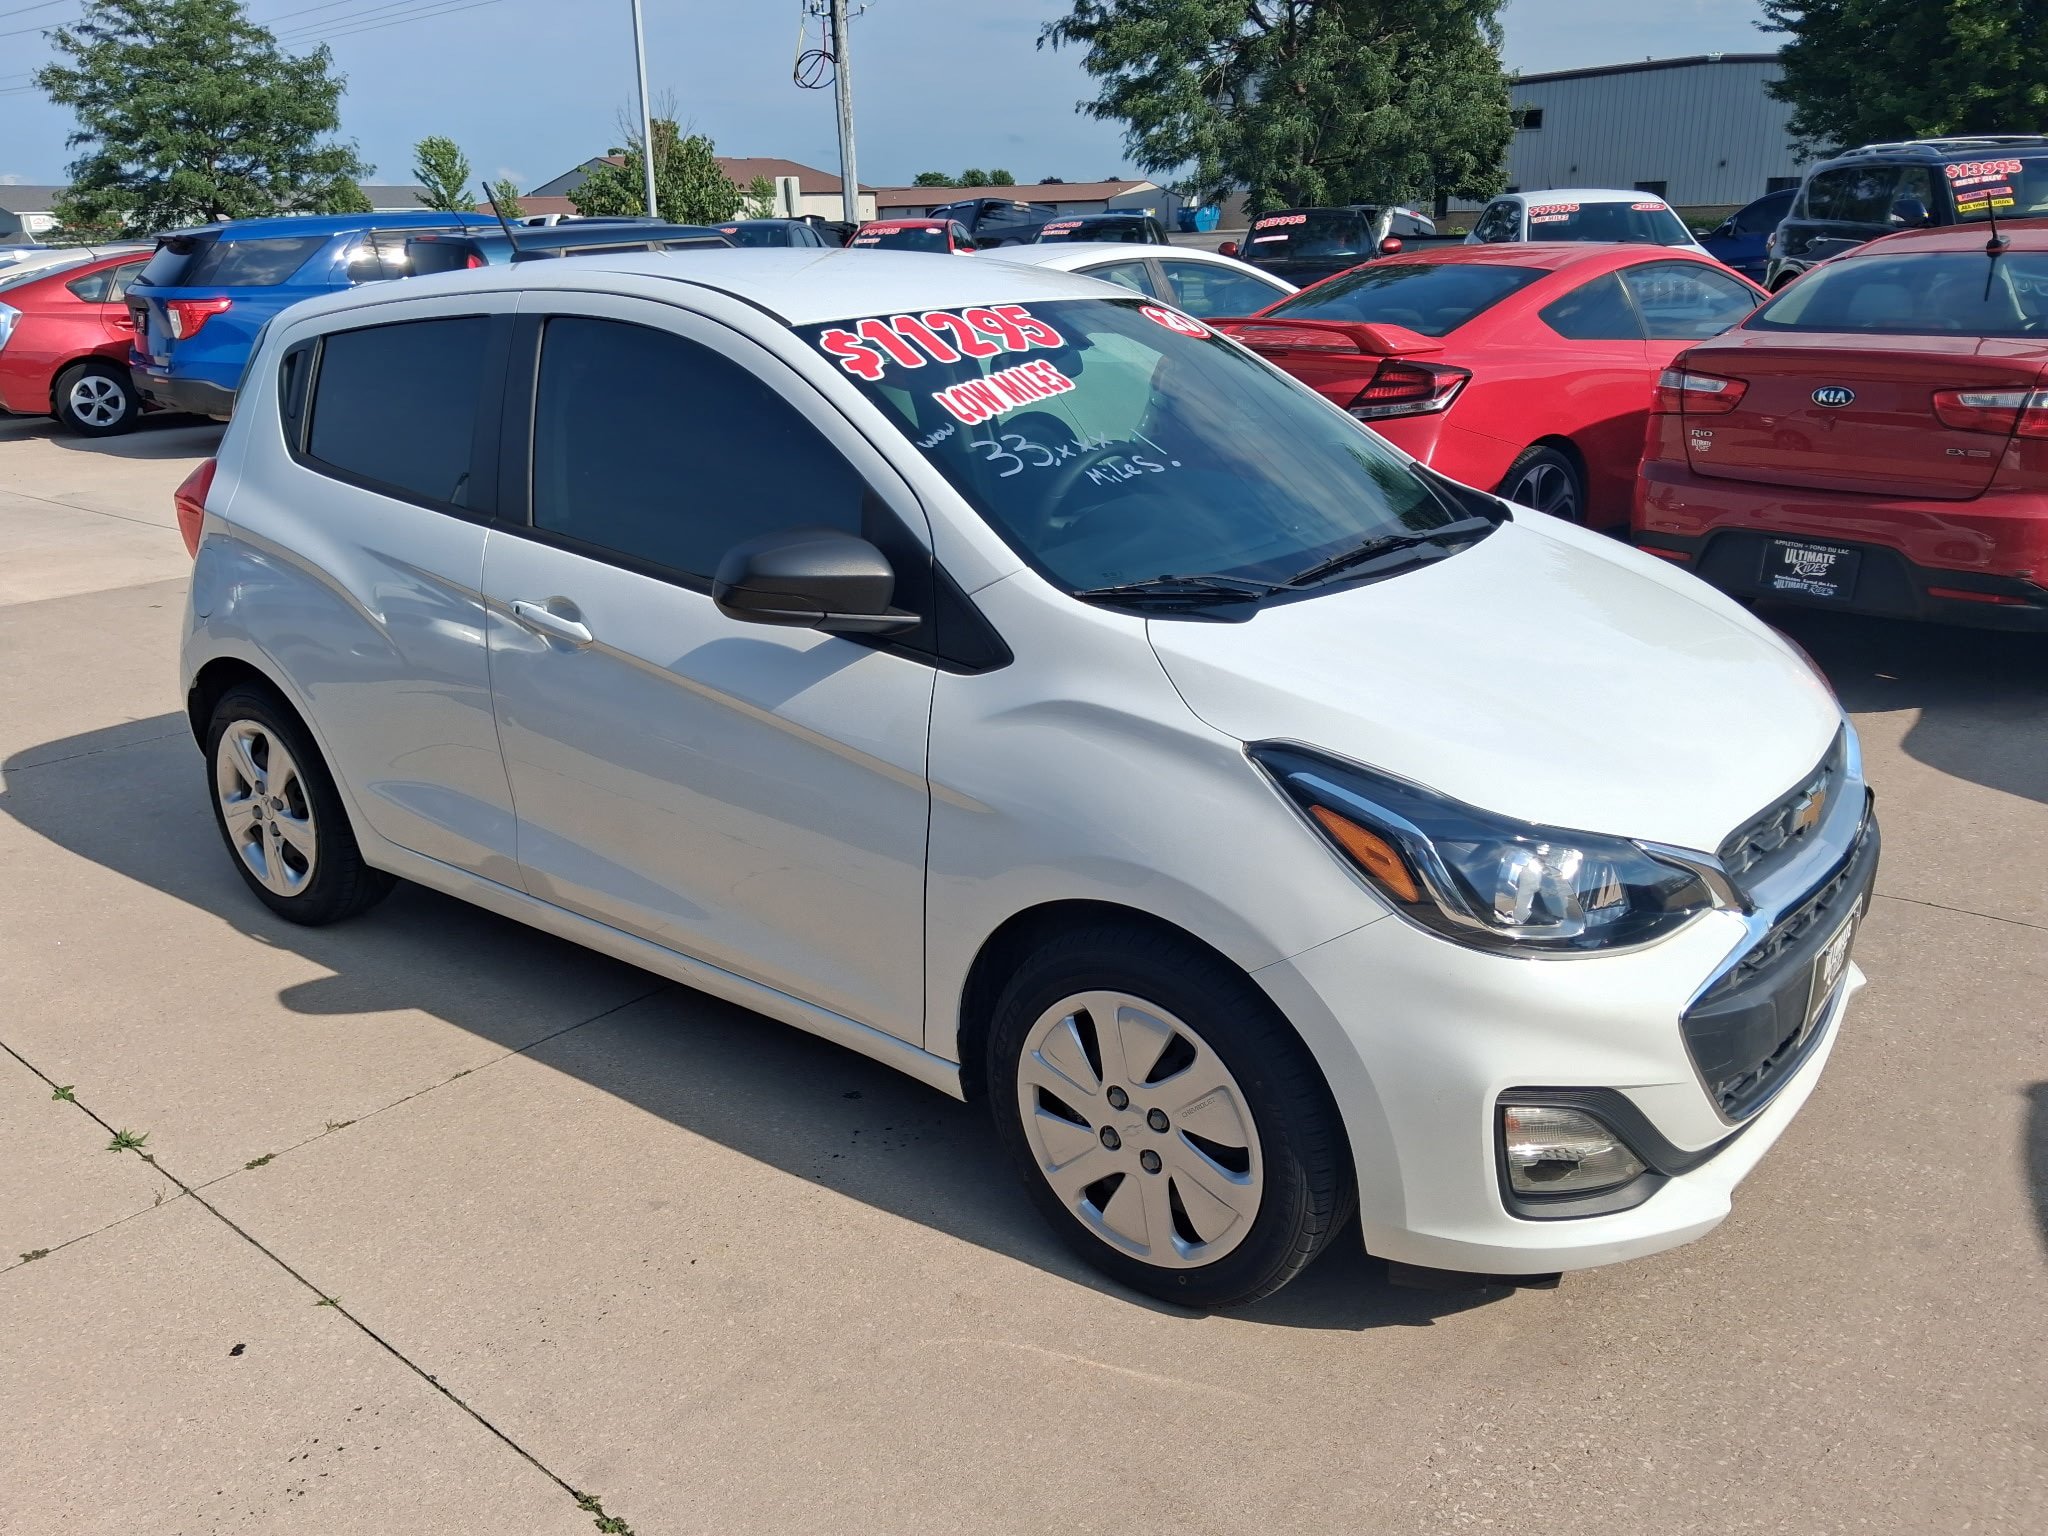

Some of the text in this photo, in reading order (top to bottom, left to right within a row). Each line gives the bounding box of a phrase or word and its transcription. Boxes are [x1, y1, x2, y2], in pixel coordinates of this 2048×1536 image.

[1946, 160, 2023, 178] $13995
[1957, 177, 1981, 187] BEST
[1529, 203, 1580, 217] $9995
[1960, 202, 1973, 211] ALL
[1255, 214, 1307, 231] $13995
[820, 305, 1064, 381] $11295
[932, 359, 1076, 425] LOW MILES
[1817, 389, 1846, 404] KIA
[1784, 548, 1837, 564] ULTIMATE
[1810, 544, 1827, 552] FOND
[1792, 561, 1829, 577] RIDES
[1776, 579, 1808, 589] ULTIMATE
[1181, 1097, 1216, 1118] CHEVROLET
